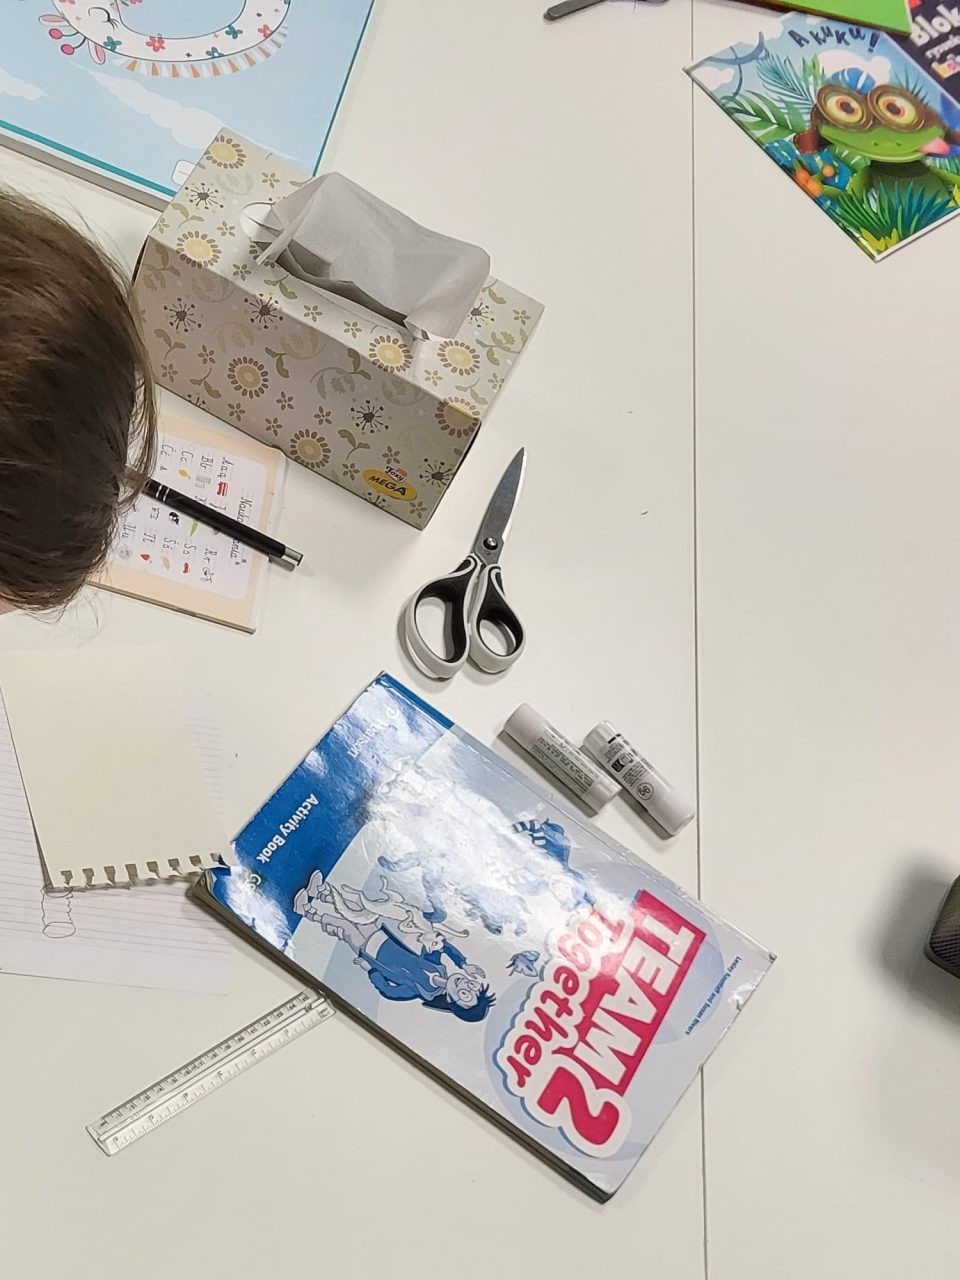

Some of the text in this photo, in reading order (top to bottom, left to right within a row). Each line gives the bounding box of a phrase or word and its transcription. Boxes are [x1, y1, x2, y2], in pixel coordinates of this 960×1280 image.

[369, 476, 407, 496] MEGA
[256, 793, 320, 865] Activity Book
[572, 914, 696, 1086] TEAM
[536, 1066, 620, 1145] 2
